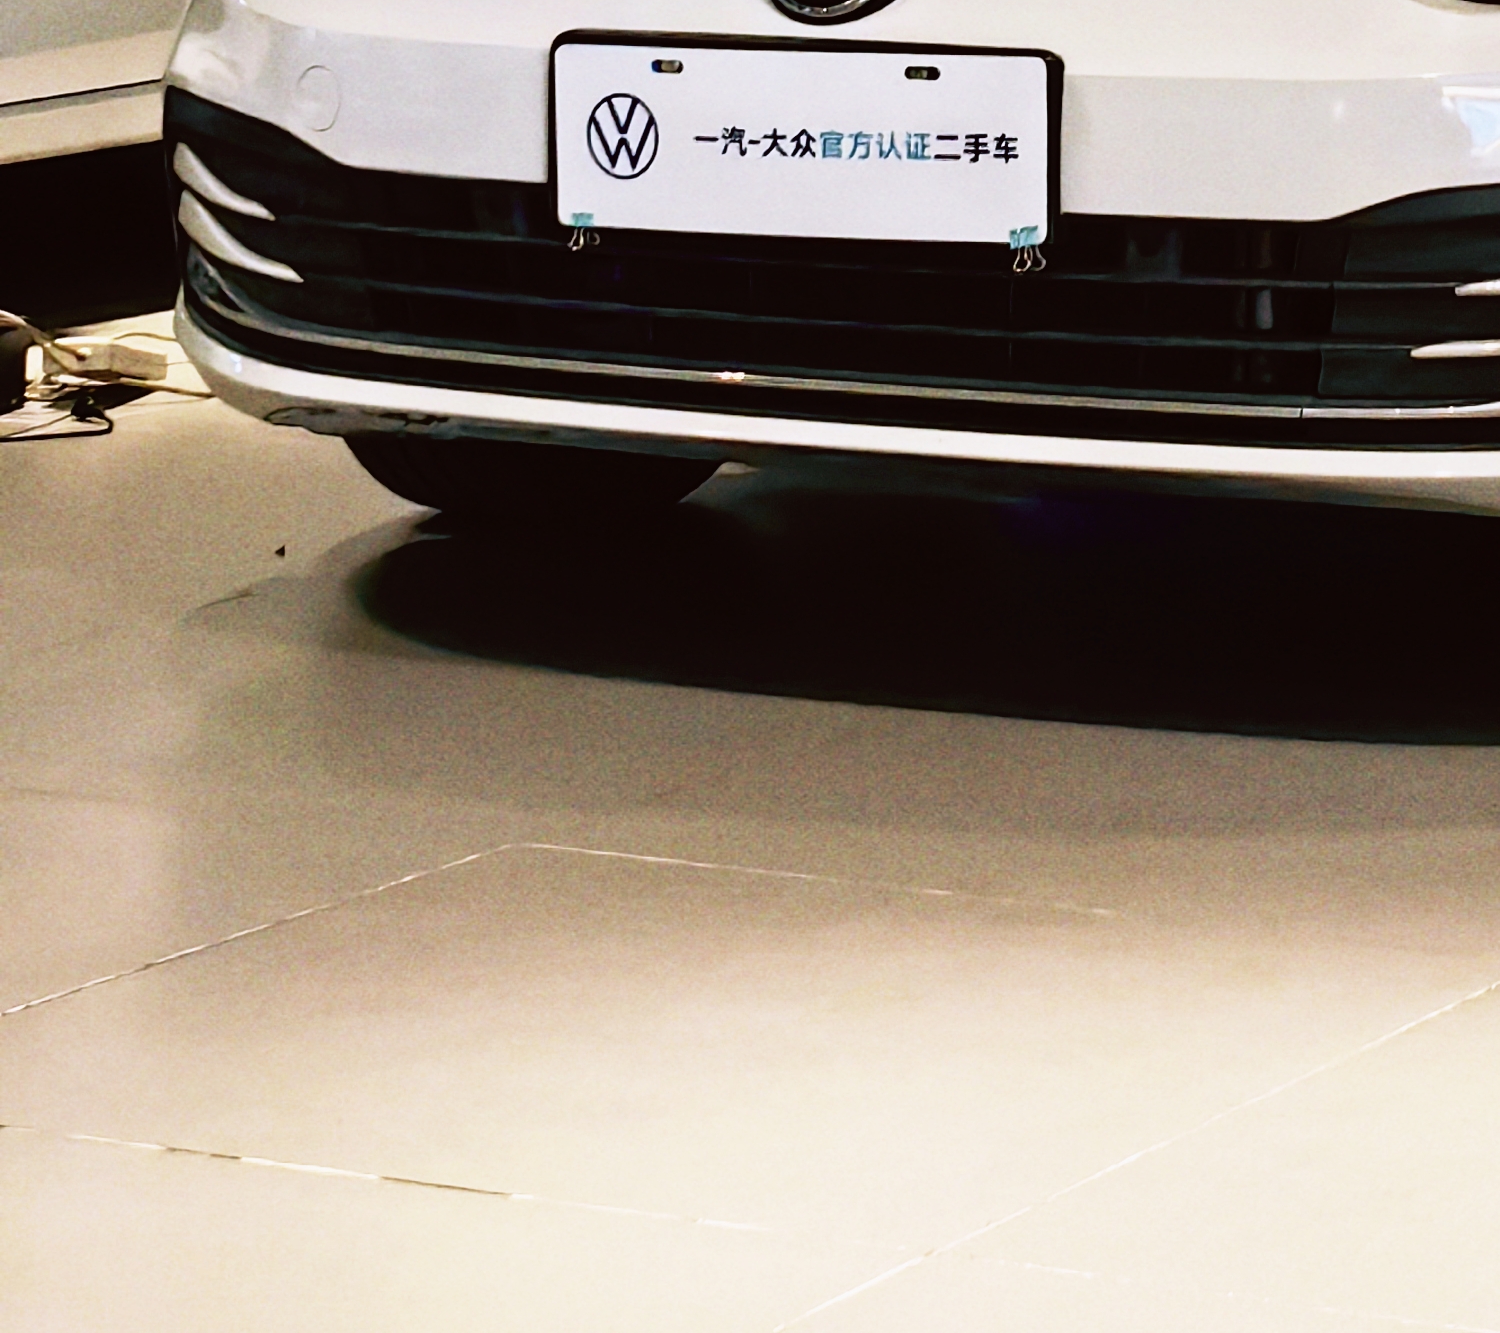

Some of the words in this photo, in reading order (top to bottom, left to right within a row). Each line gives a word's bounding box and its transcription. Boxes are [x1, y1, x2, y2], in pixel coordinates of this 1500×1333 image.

[694, 127, 1019, 163] 一汽-大众官方认证二手车
